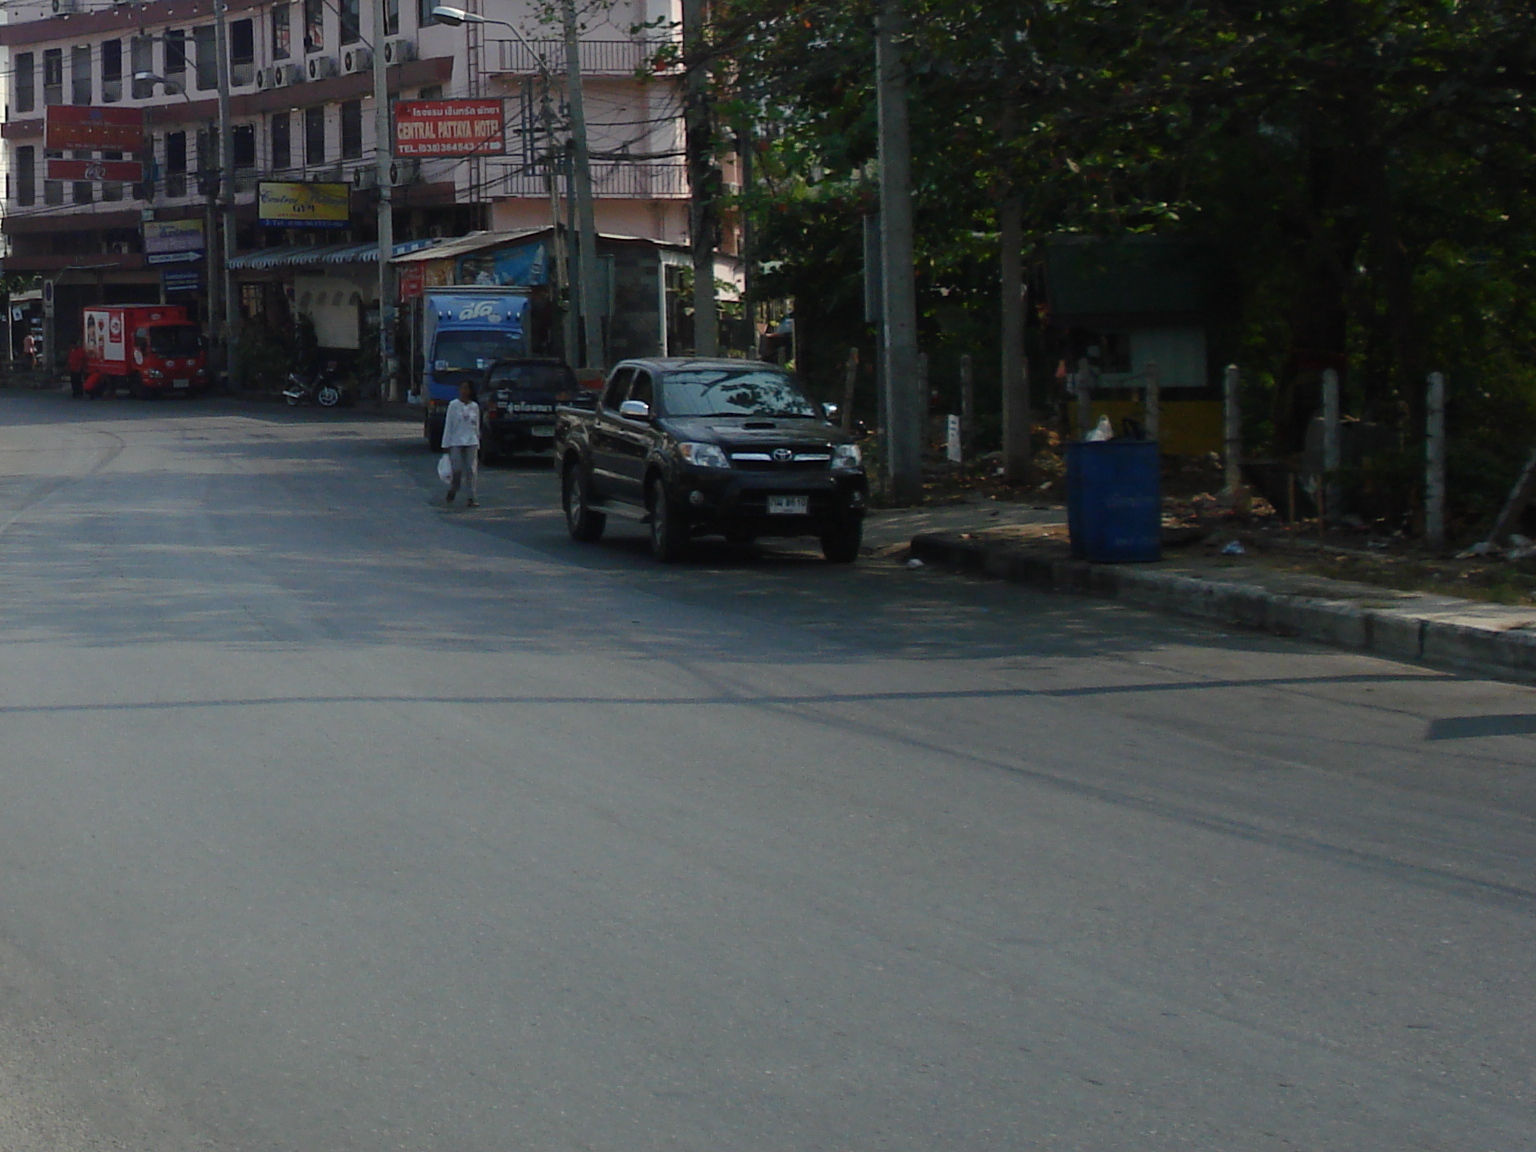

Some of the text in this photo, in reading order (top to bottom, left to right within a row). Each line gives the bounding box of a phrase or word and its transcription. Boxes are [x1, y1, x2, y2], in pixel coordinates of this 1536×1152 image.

[397, 119, 501, 140] CENTRAL PATTAYA HOTEL
[292, 204, 314, 213] GYM
